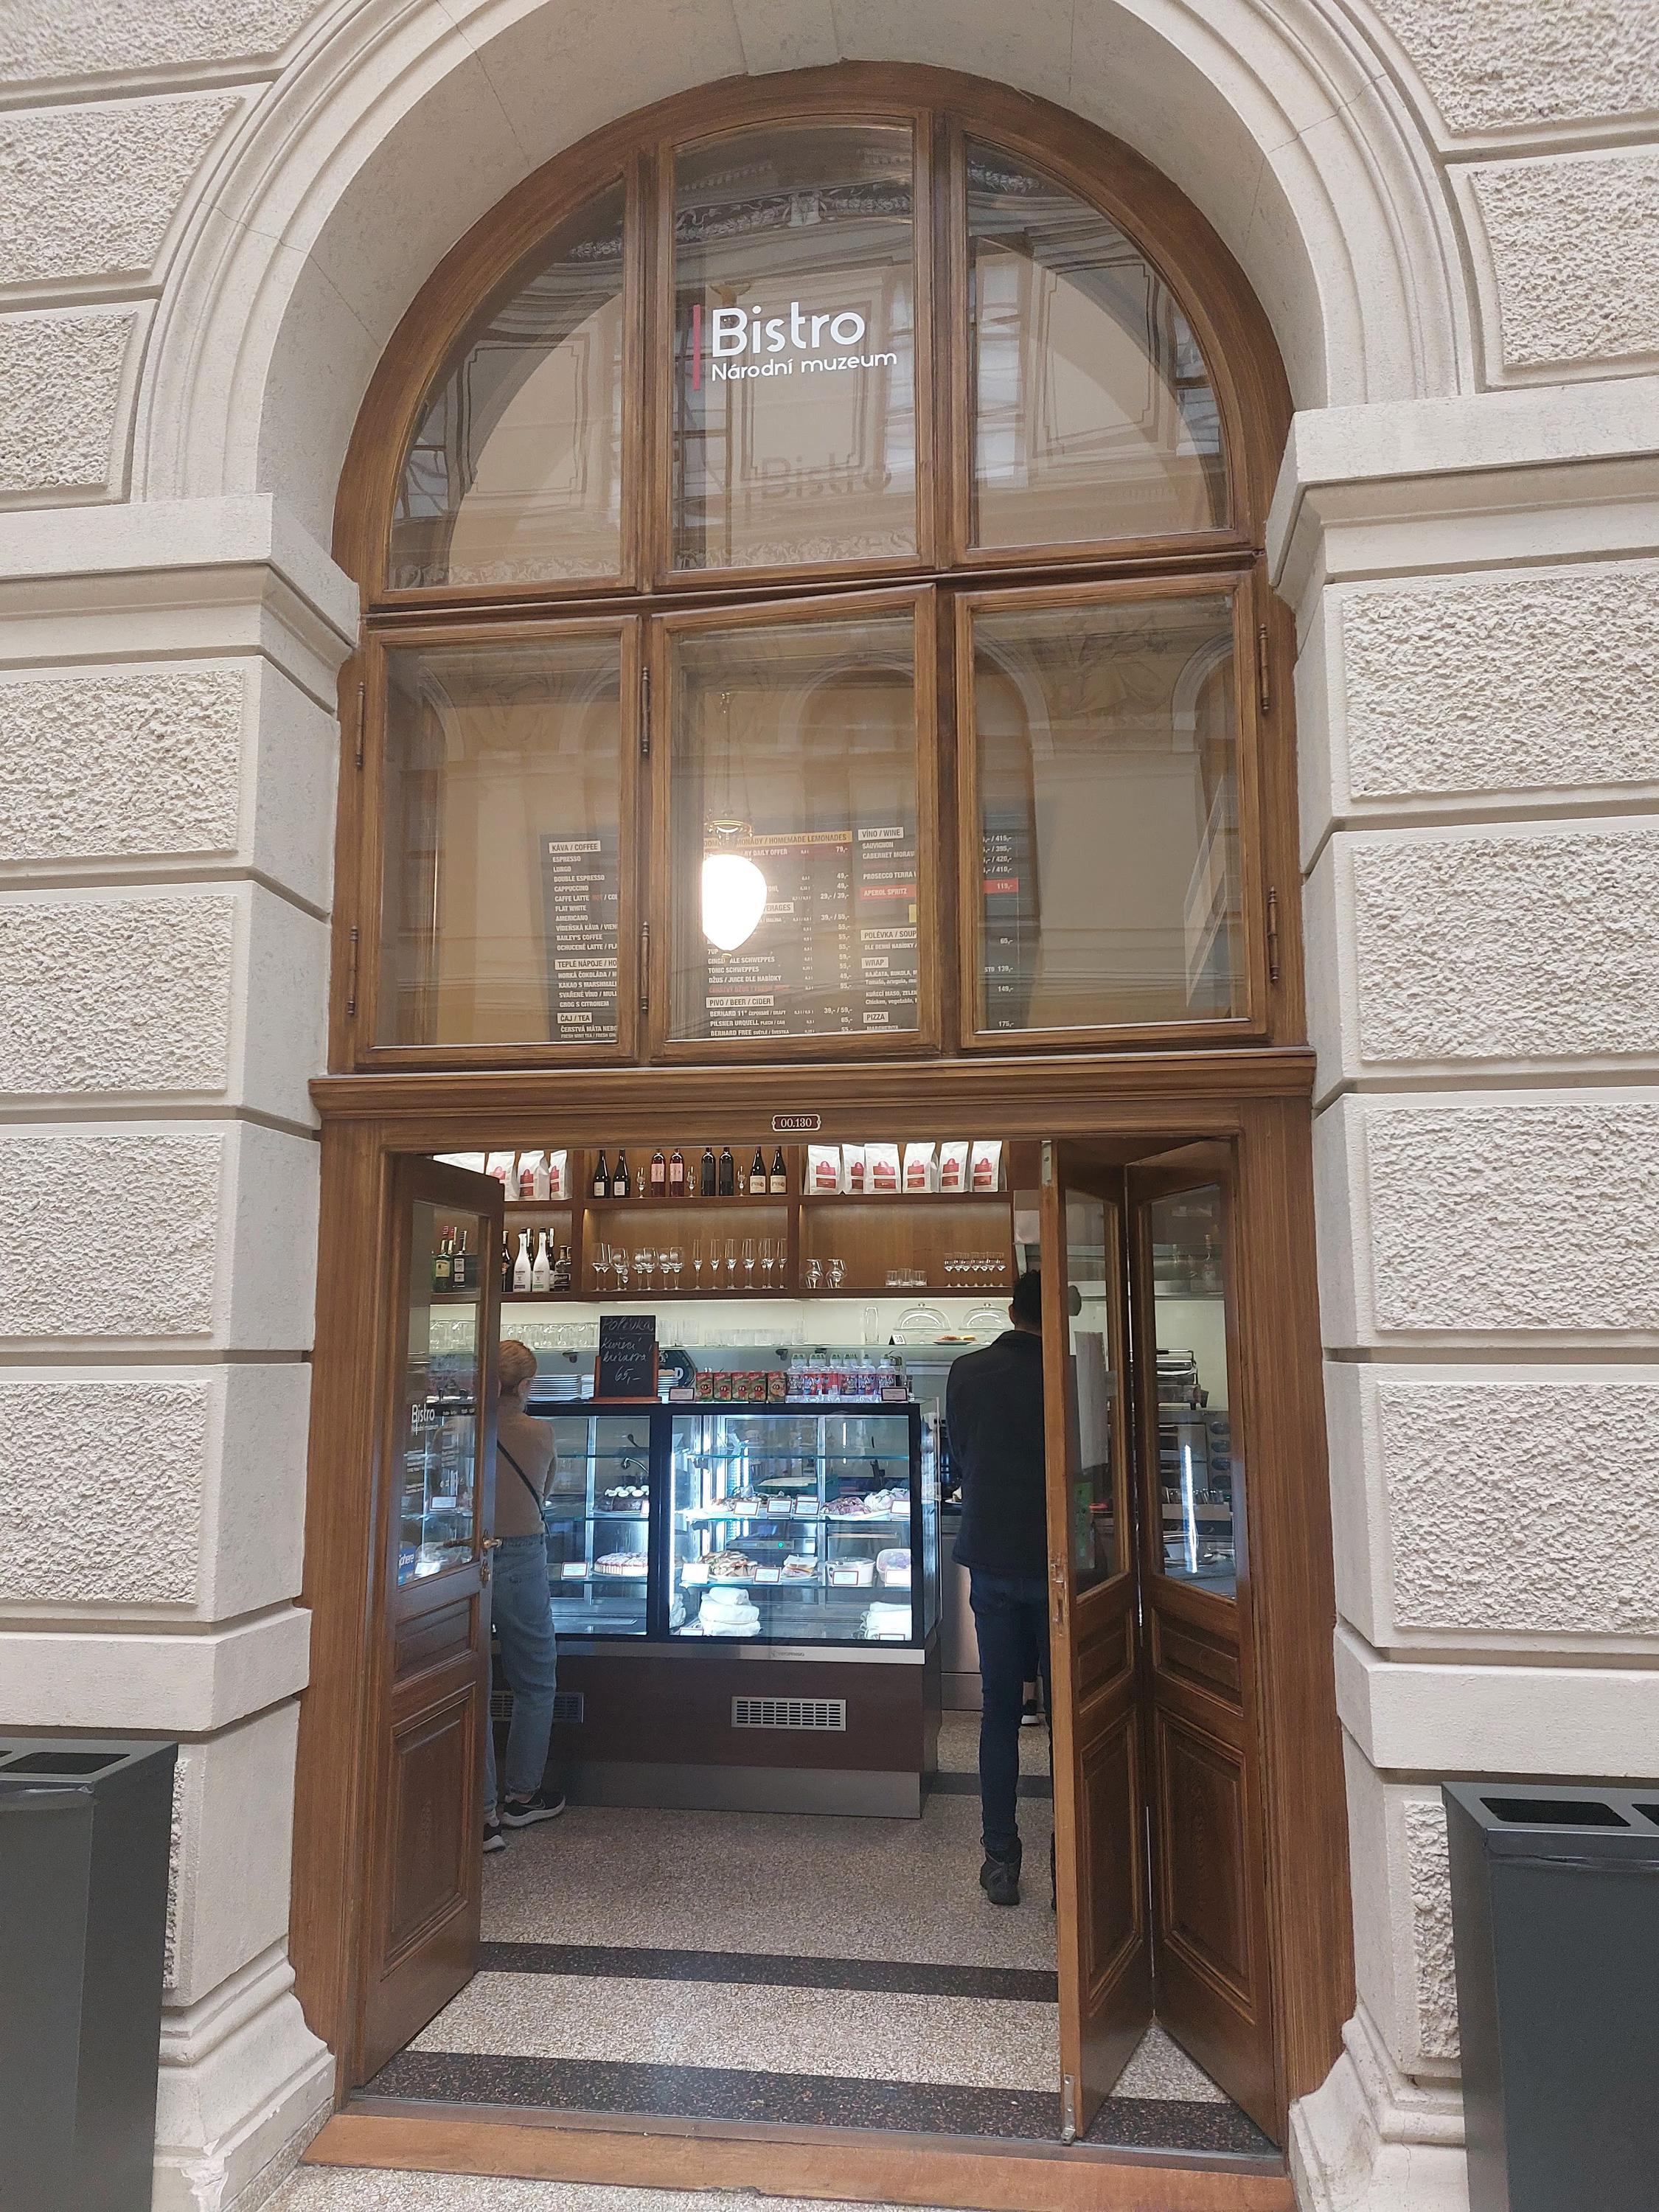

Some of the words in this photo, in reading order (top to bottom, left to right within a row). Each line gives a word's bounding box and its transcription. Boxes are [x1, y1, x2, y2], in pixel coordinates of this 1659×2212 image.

[712, 302, 865, 357] Bistro
[712, 358, 793, 381] Národní
[801, 352, 897, 373] muzeum
[769, 836, 804, 844] HOMEMADE
[807, 834, 847, 842] LEMONADES
[781, 1118, 812, 1127] 00.130
[411, 1403, 435, 1423] Bistro
